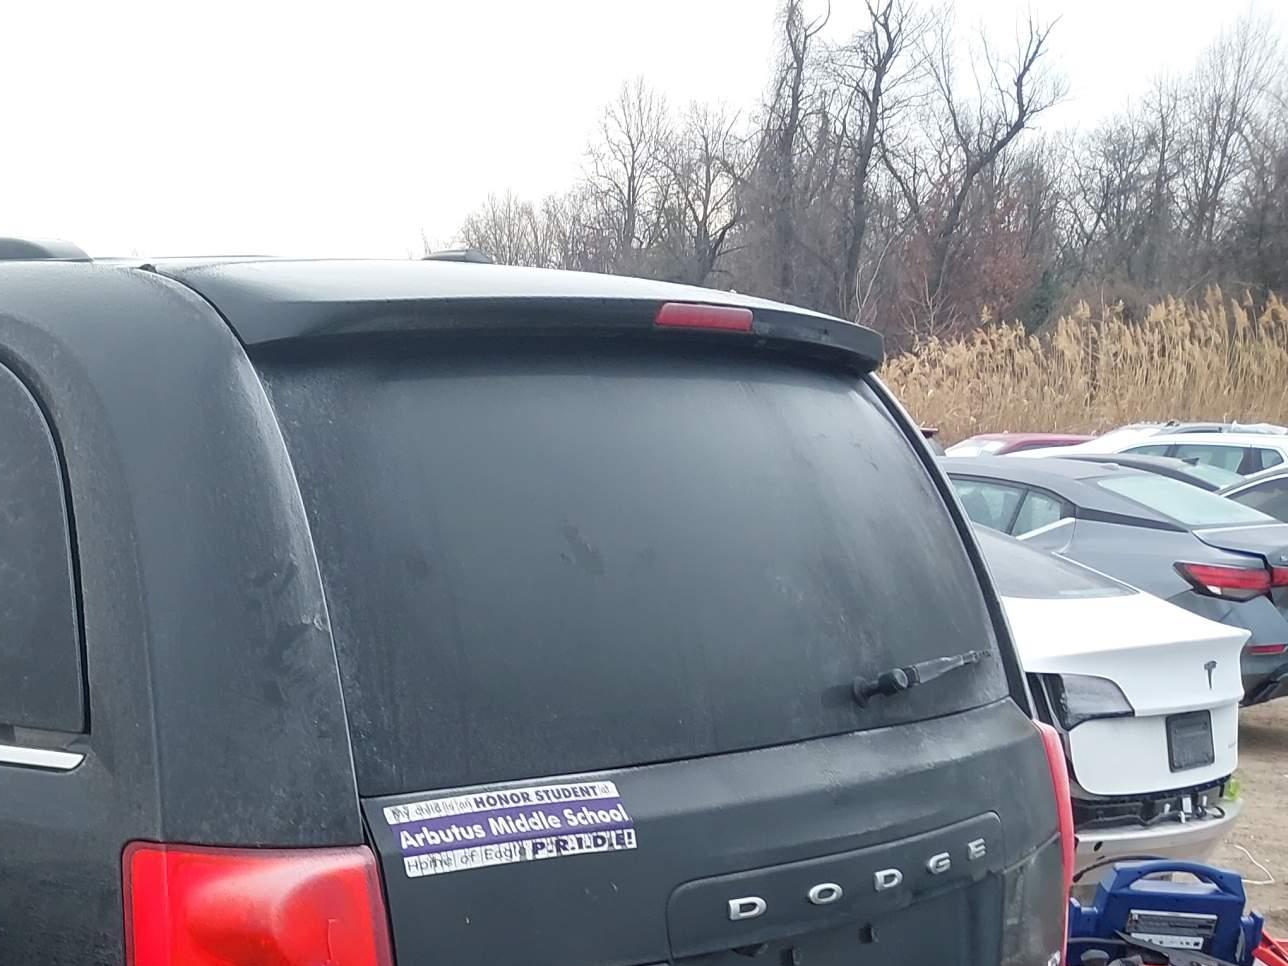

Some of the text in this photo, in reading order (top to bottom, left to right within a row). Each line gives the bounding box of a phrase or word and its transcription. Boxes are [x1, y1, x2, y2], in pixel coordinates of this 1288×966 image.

[474, 791, 534, 809] HONOR
[535, 785, 600, 804] STUDENT
[400, 803, 630, 850] Arbutus Middle School
[460, 849, 477, 865] of
[727, 837, 988, 921] DODGE
